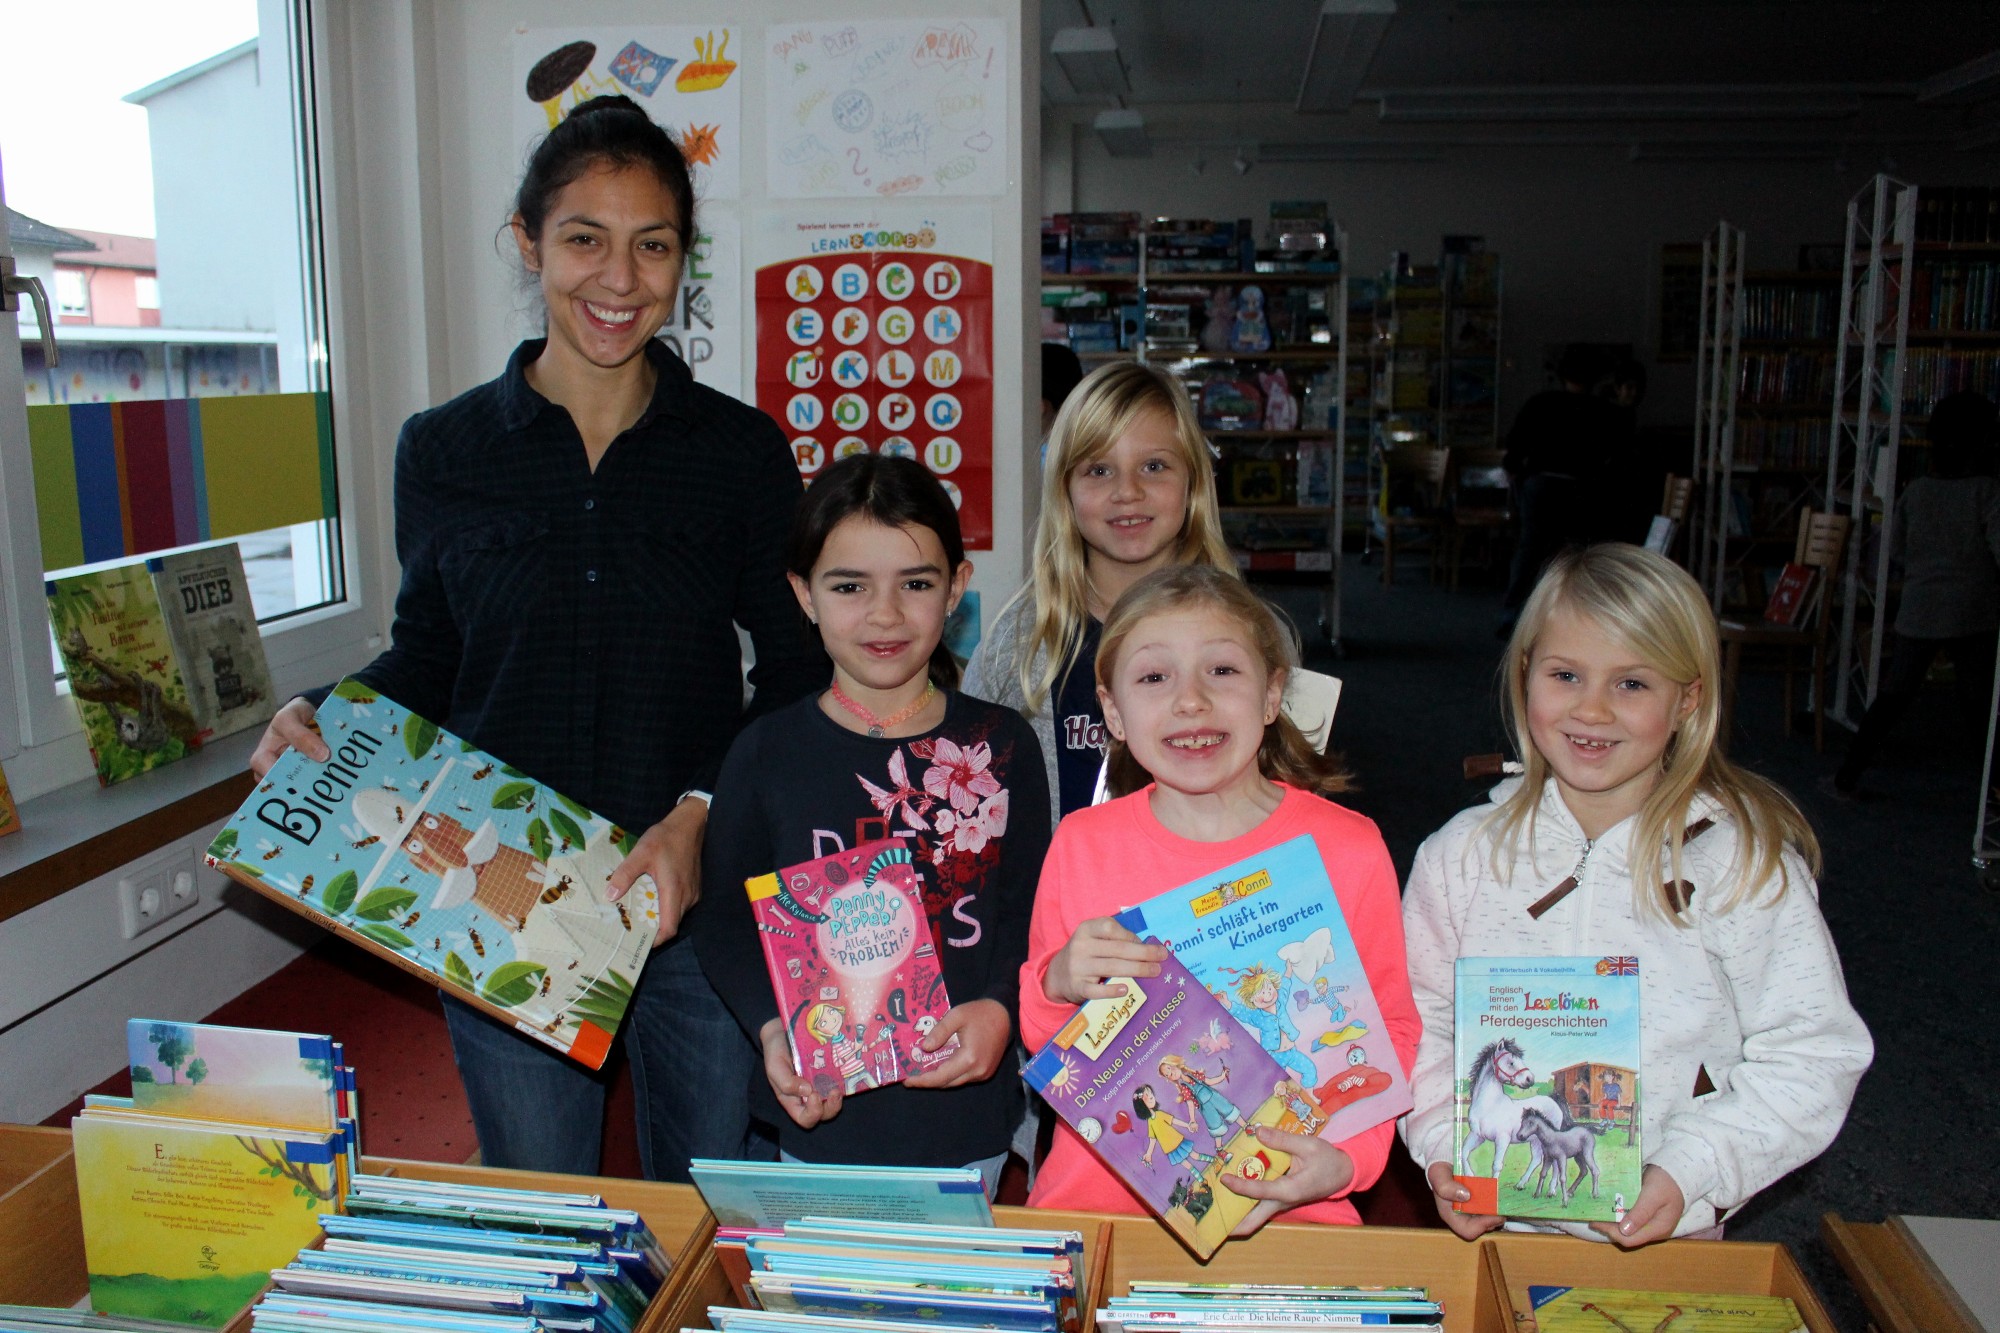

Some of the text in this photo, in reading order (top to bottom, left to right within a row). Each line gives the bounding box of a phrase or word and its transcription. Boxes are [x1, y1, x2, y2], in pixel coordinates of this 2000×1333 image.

[841, 272, 861, 296] B
[933, 270, 955, 295] D
[885, 314, 907, 339] G
[931, 357, 954, 381] M
[794, 400, 814, 424] N
[931, 400, 957, 426] Q
[933, 444, 952, 469] U
[180, 578, 233, 614] DIEB
[256, 729, 383, 846] Bienen
[1237, 871, 1269, 897] Conni
[830, 890, 885, 919] Penny
[1207, 906, 1257, 939] schläft
[1260, 901, 1279, 915] im
[1228, 902, 1324, 950] Kindergarten
[836, 934, 904, 967] PROBLEM!
[844, 928, 896, 951] Alles kein
[1489, 986, 1524, 996] Englisch
[1489, 995, 1514, 1003] lernen
[1524, 991, 1600, 1011] Leselöwen
[1480, 1014, 1608, 1030] Pferdegeschichten
[921, 1048, 954, 1062] dtv junior
[1074, 990, 1186, 1109] Die Neue in der Klasse
[1102, 1084, 1119, 1103] Katja
[1136, 1037, 1164, 1066] Franziska
[1162, 1018, 1182, 1039] Harvey
[1203, 1312, 1220, 1320] Eric
[1222, 1312, 1245, 1320] Carle
[1249, 1312, 1264, 1321] Die
[1266, 1312, 1291, 1321] kleine
[1293, 1313, 1321, 1324] Raupe
